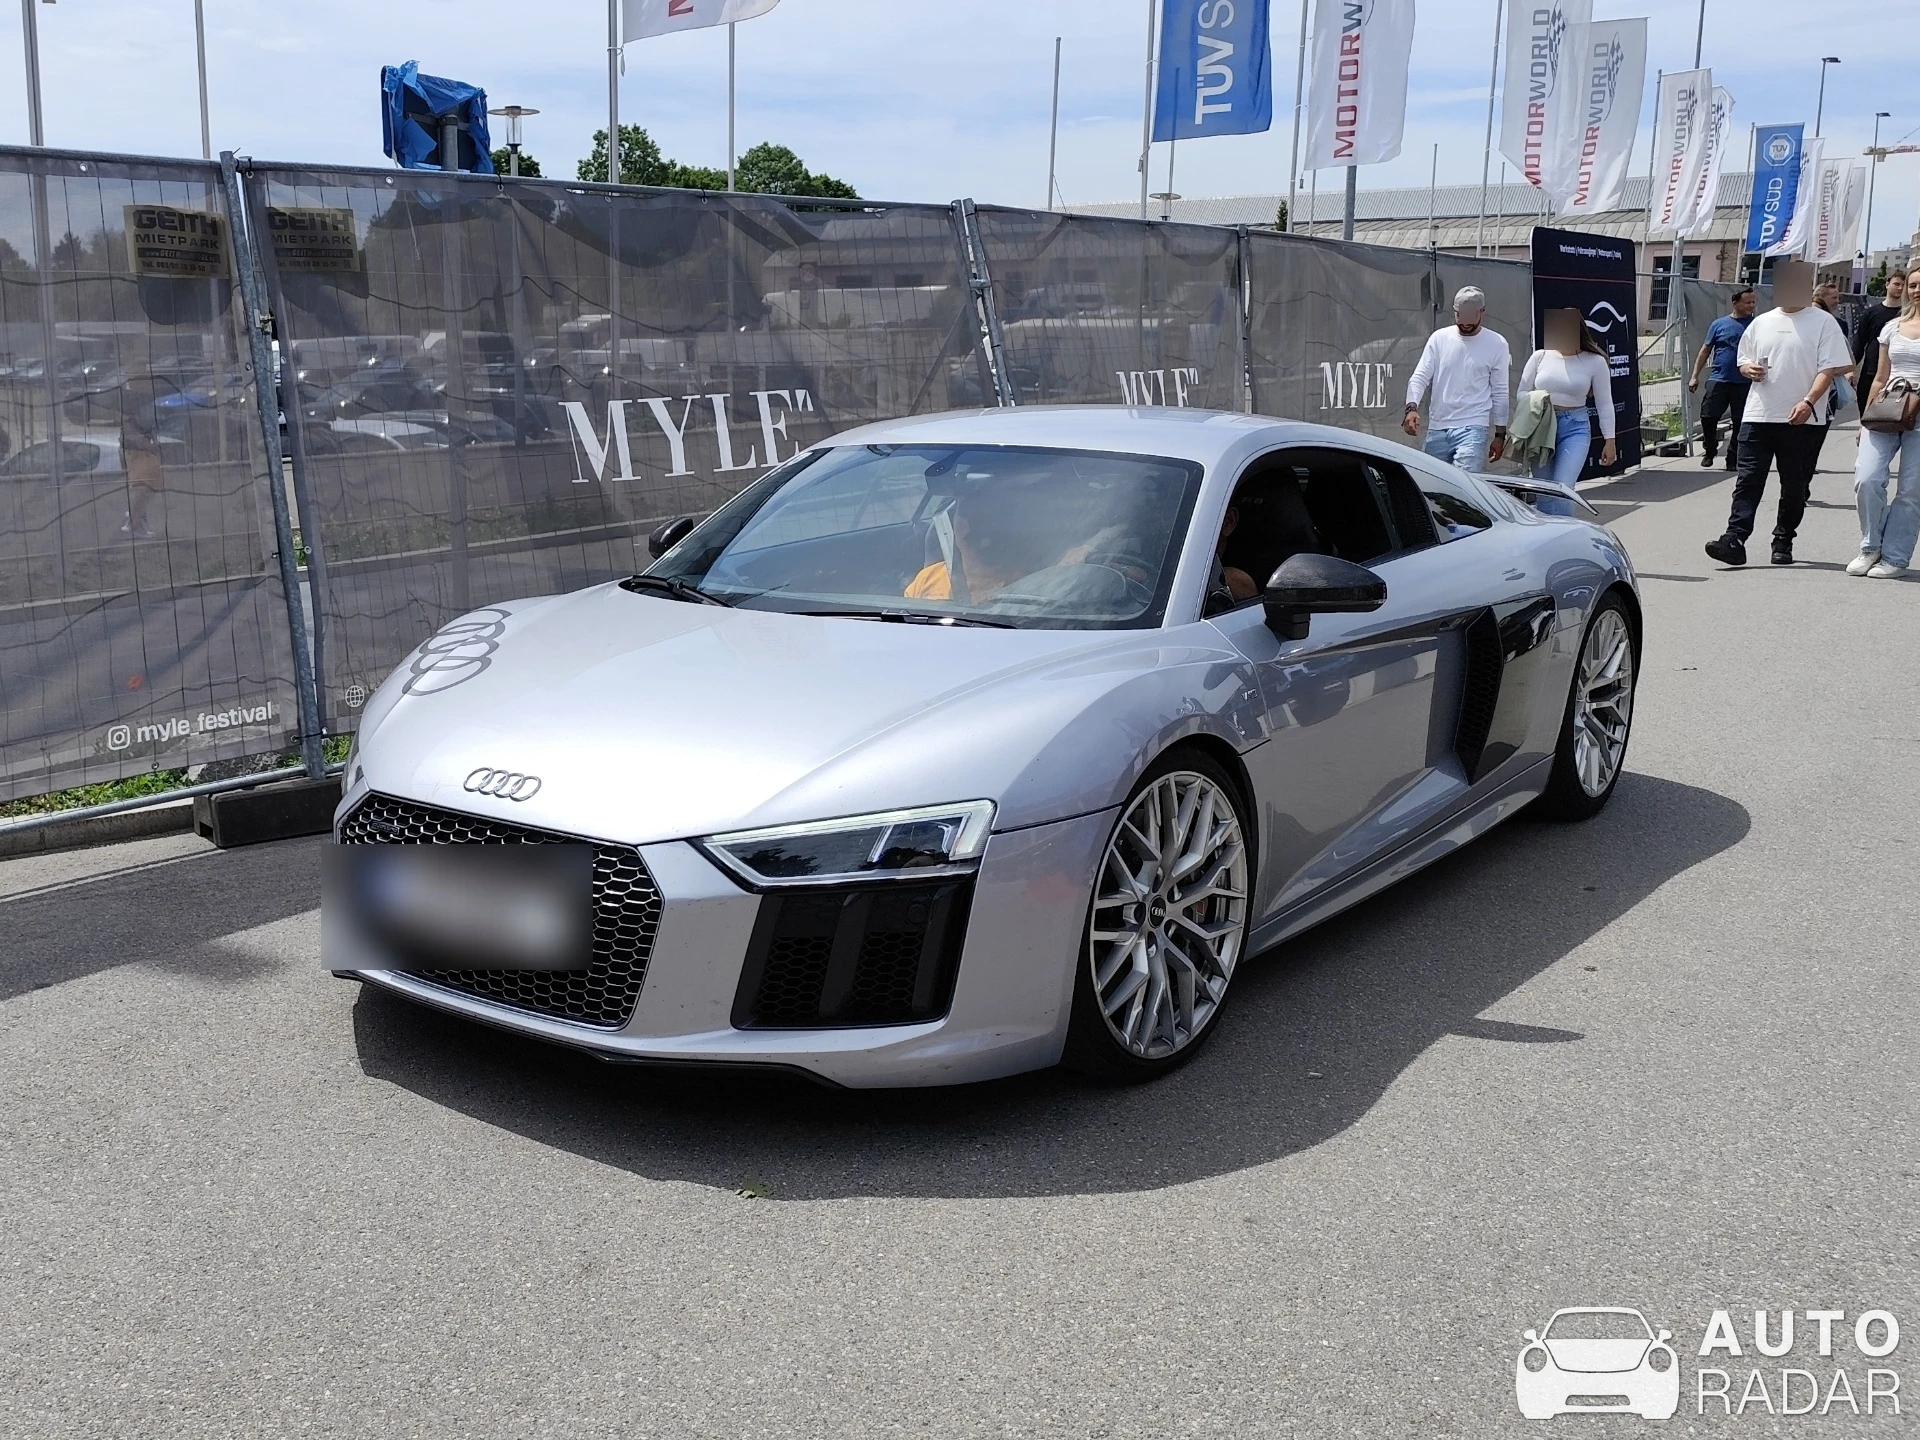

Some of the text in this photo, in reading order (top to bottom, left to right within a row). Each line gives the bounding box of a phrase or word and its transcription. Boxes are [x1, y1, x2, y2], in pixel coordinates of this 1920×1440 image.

[1195, 35, 1234, 125] TÜV
[1573, 42, 1609, 206] MOTORWORLD
[1661, 89, 1688, 224] MOTORWORLD
[133, 209, 218, 236] GEITH
[135, 233, 219, 250] MIETPARK
[267, 211, 350, 232] GEITH
[137, 701, 273, 743] myle_festival
